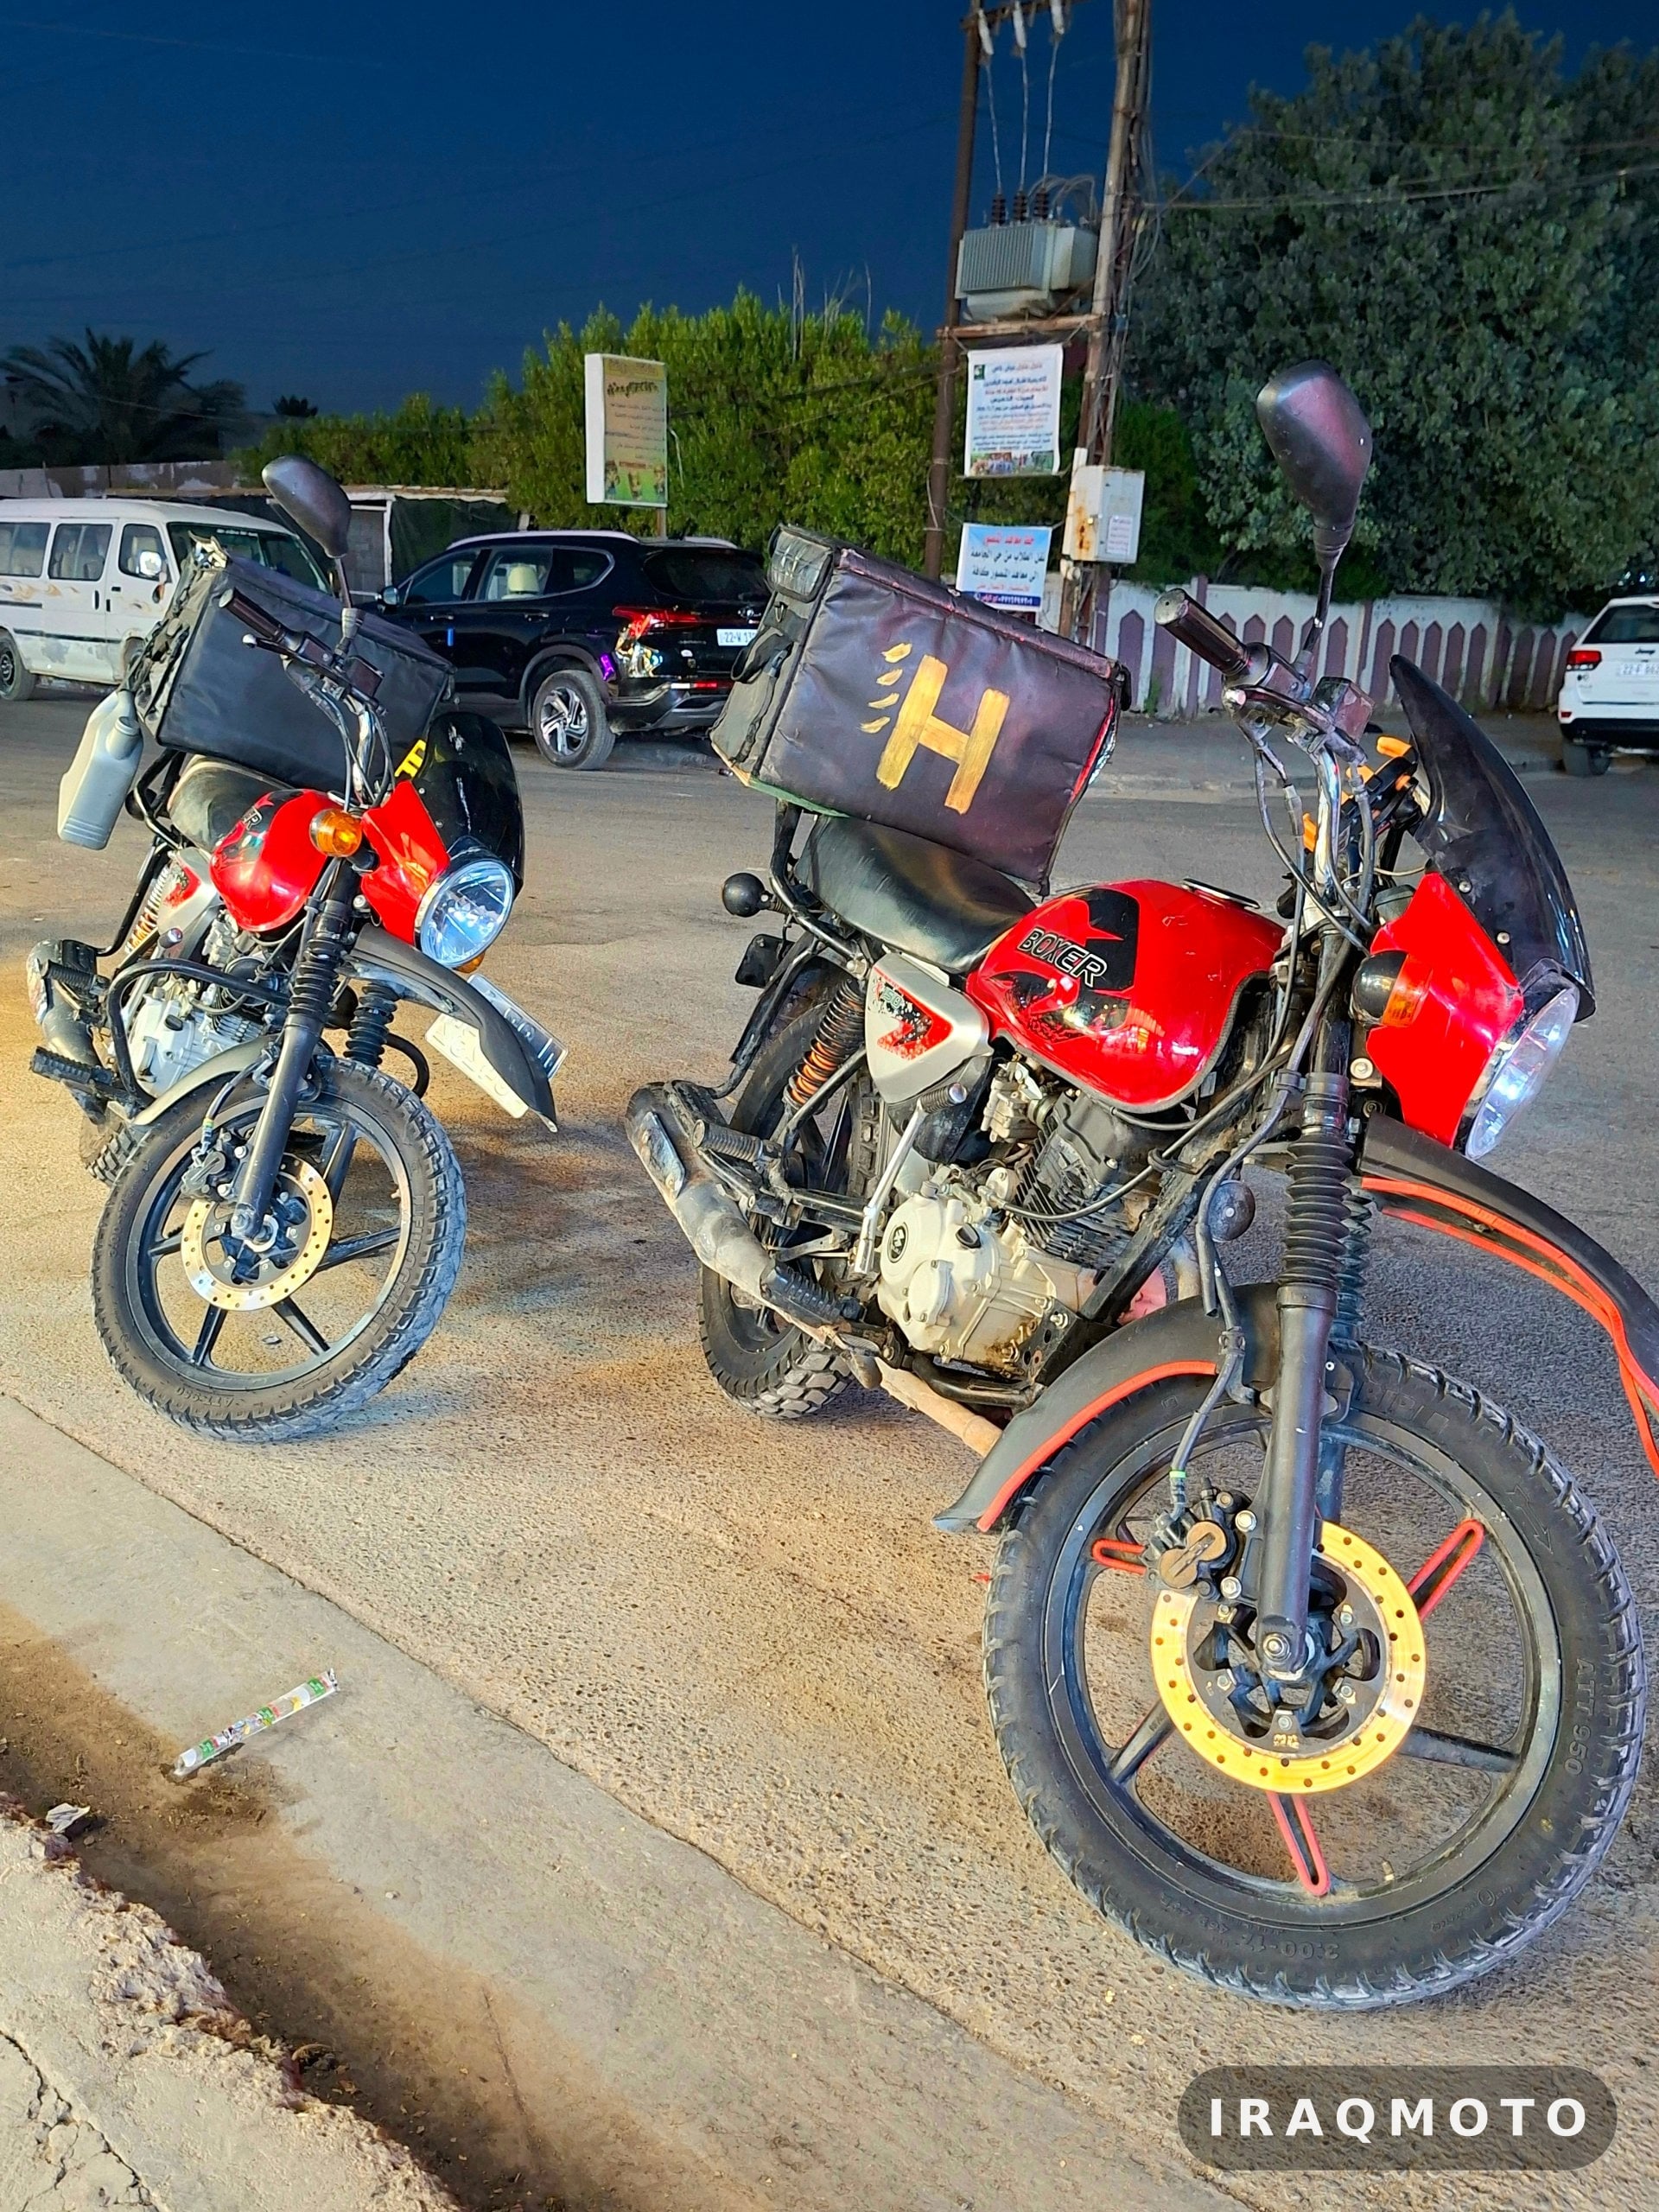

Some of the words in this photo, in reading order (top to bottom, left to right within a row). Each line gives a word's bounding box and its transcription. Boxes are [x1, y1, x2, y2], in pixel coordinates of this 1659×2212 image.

[875, 654, 1010, 815] H
[1017, 926, 1108, 988] BOXER
[1575, 1658, 1597, 1717] ATT
[1564, 1724, 1592, 1777] 950
